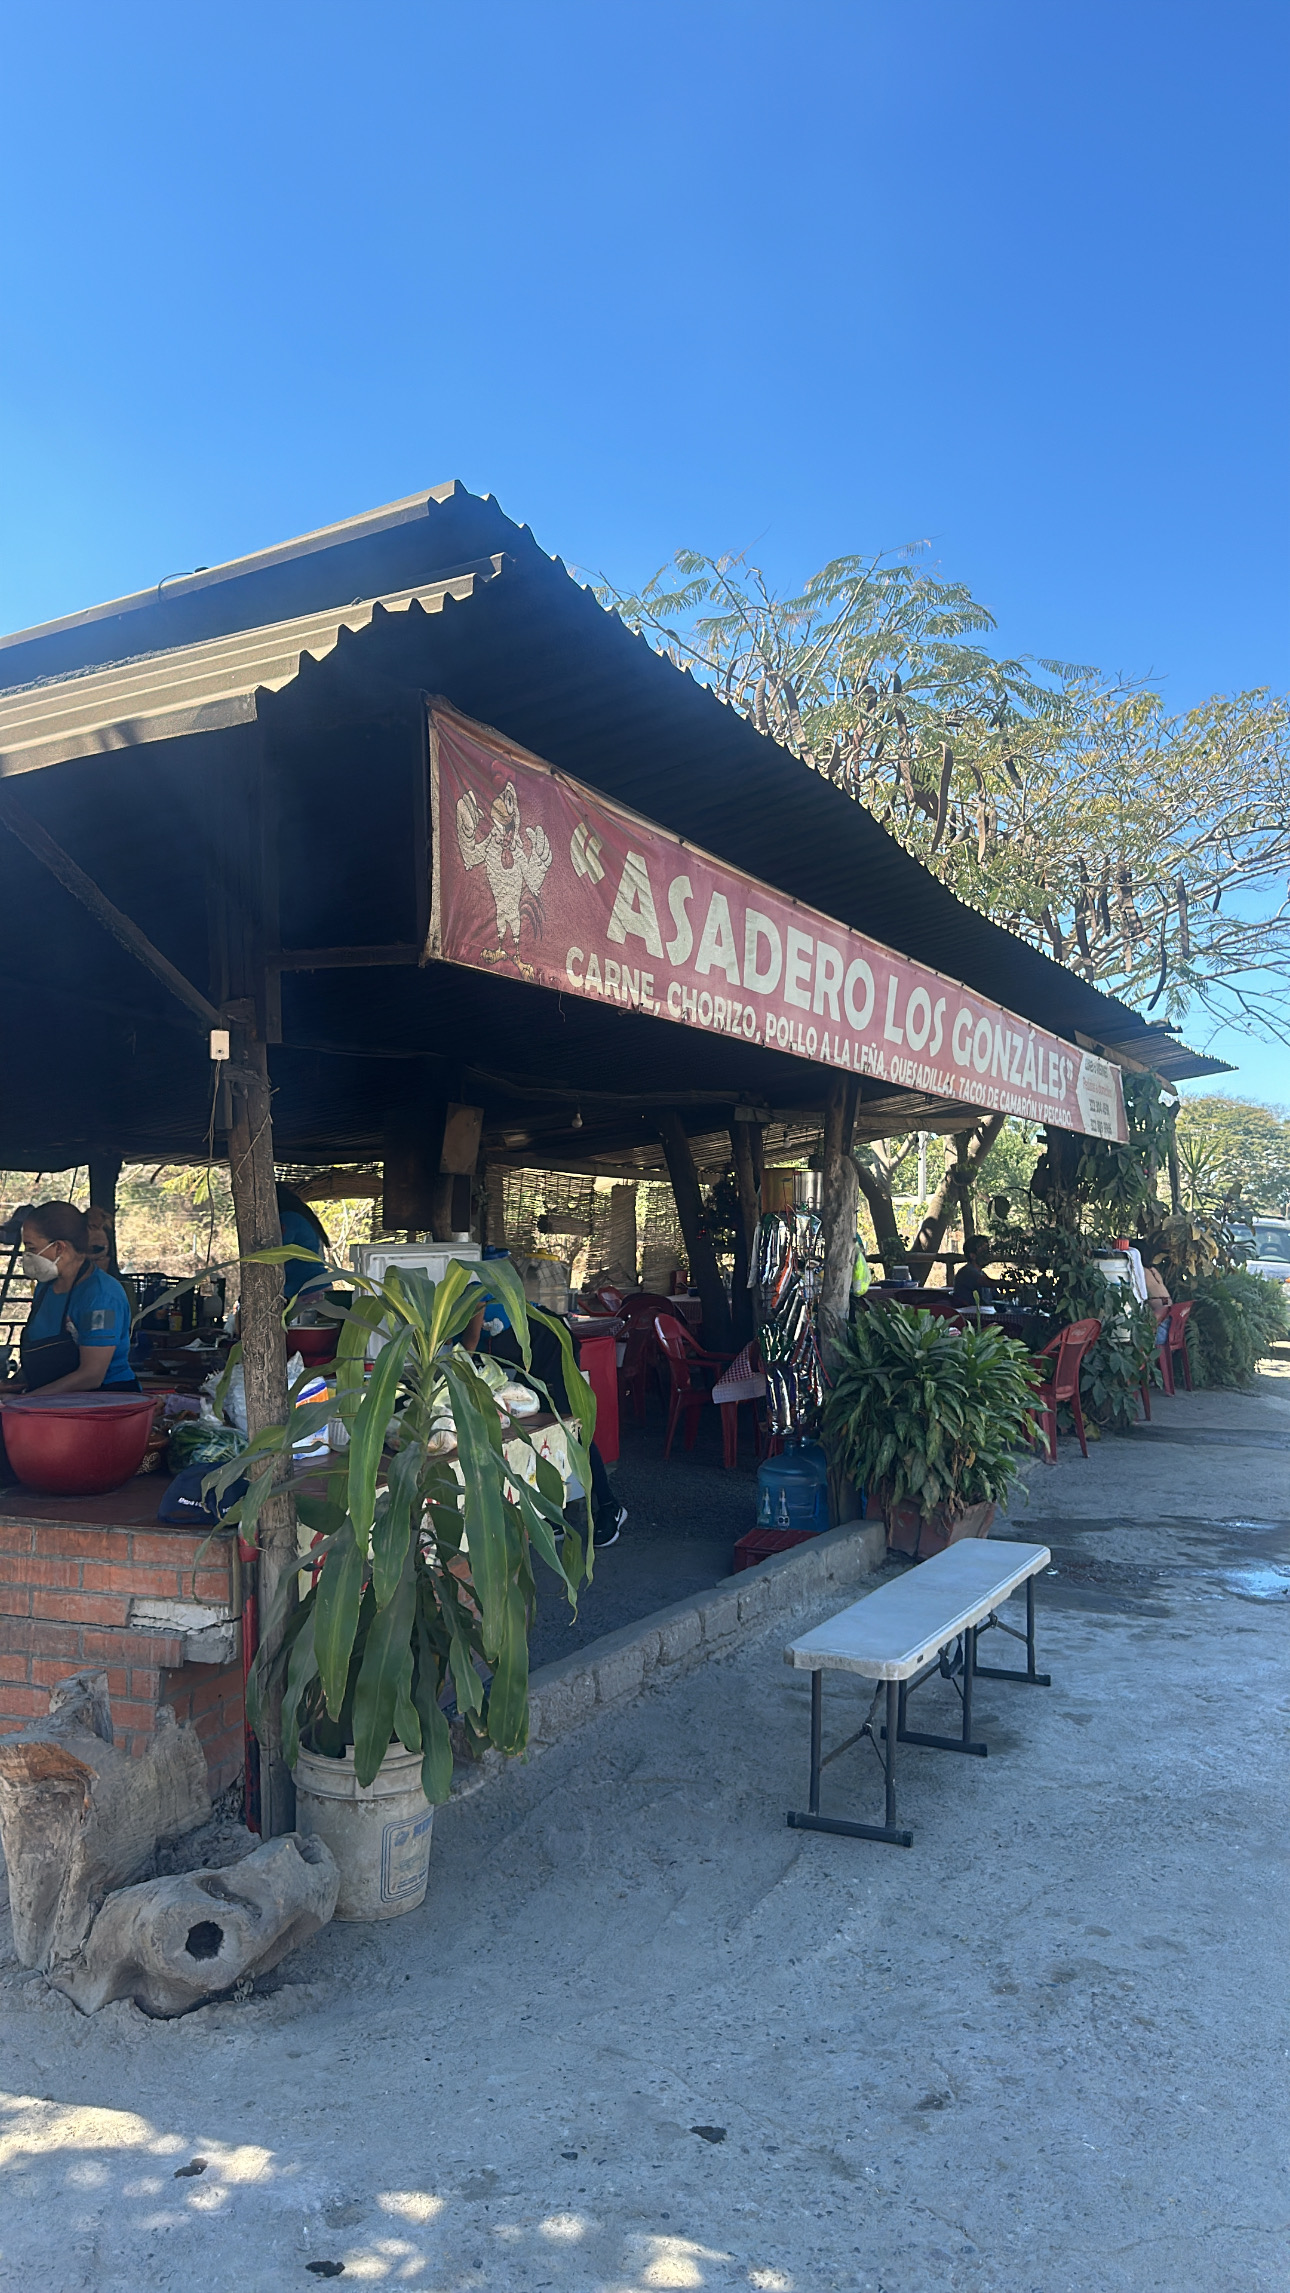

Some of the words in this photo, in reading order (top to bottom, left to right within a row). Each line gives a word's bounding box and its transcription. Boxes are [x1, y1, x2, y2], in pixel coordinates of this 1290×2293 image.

[565, 946, 661, 1016] CARNE,
[667, 981, 760, 1043] CHORIZO,
[765, 1012, 818, 1056] POLLO
[820, 1032, 830, 1060] A
[833, 1035, 850, 1067] LA
[890, 1054, 956, 1097] QUESADILLAS,
[958, 1077, 986, 1104] TACOS
[987, 1086, 999, 1109] DE
[1000, 1091, 1036, 1118] CAMARÓN
[1038, 1103, 1044, 1119] Y
[884, 974, 946, 1057] LOS
